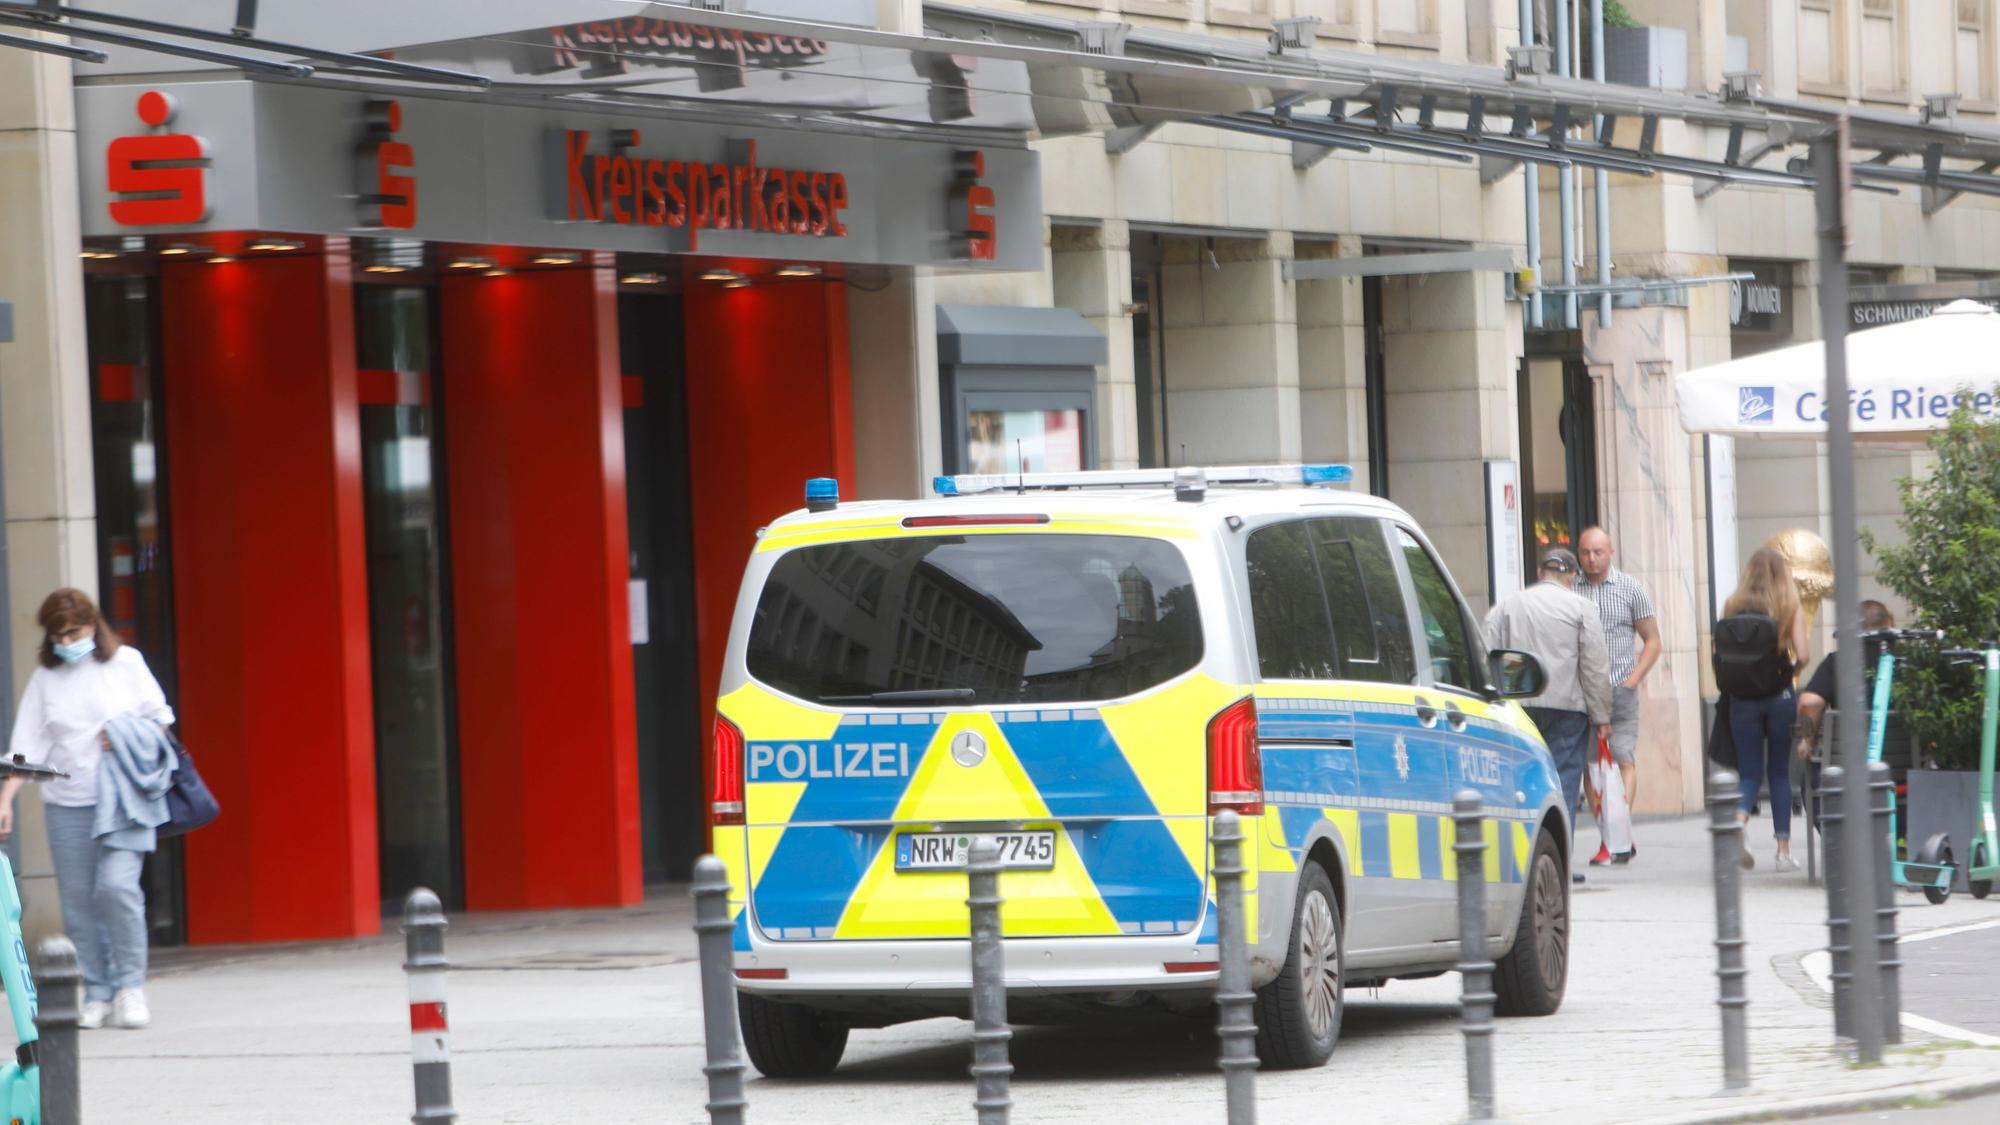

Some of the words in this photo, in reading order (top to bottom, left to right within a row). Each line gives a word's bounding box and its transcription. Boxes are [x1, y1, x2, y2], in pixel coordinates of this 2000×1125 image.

[565, 128, 849, 252] Kreissparkasse
[1854, 301, 1942, 324] SCHMUCK
[1795, 389, 1876, 422] Cé
[750, 742, 909, 779] POLIZEI
[1459, 747, 1501, 786] POLIZEI
[911, 837, 955, 863] NRW
[996, 835, 1051, 861] 7745
